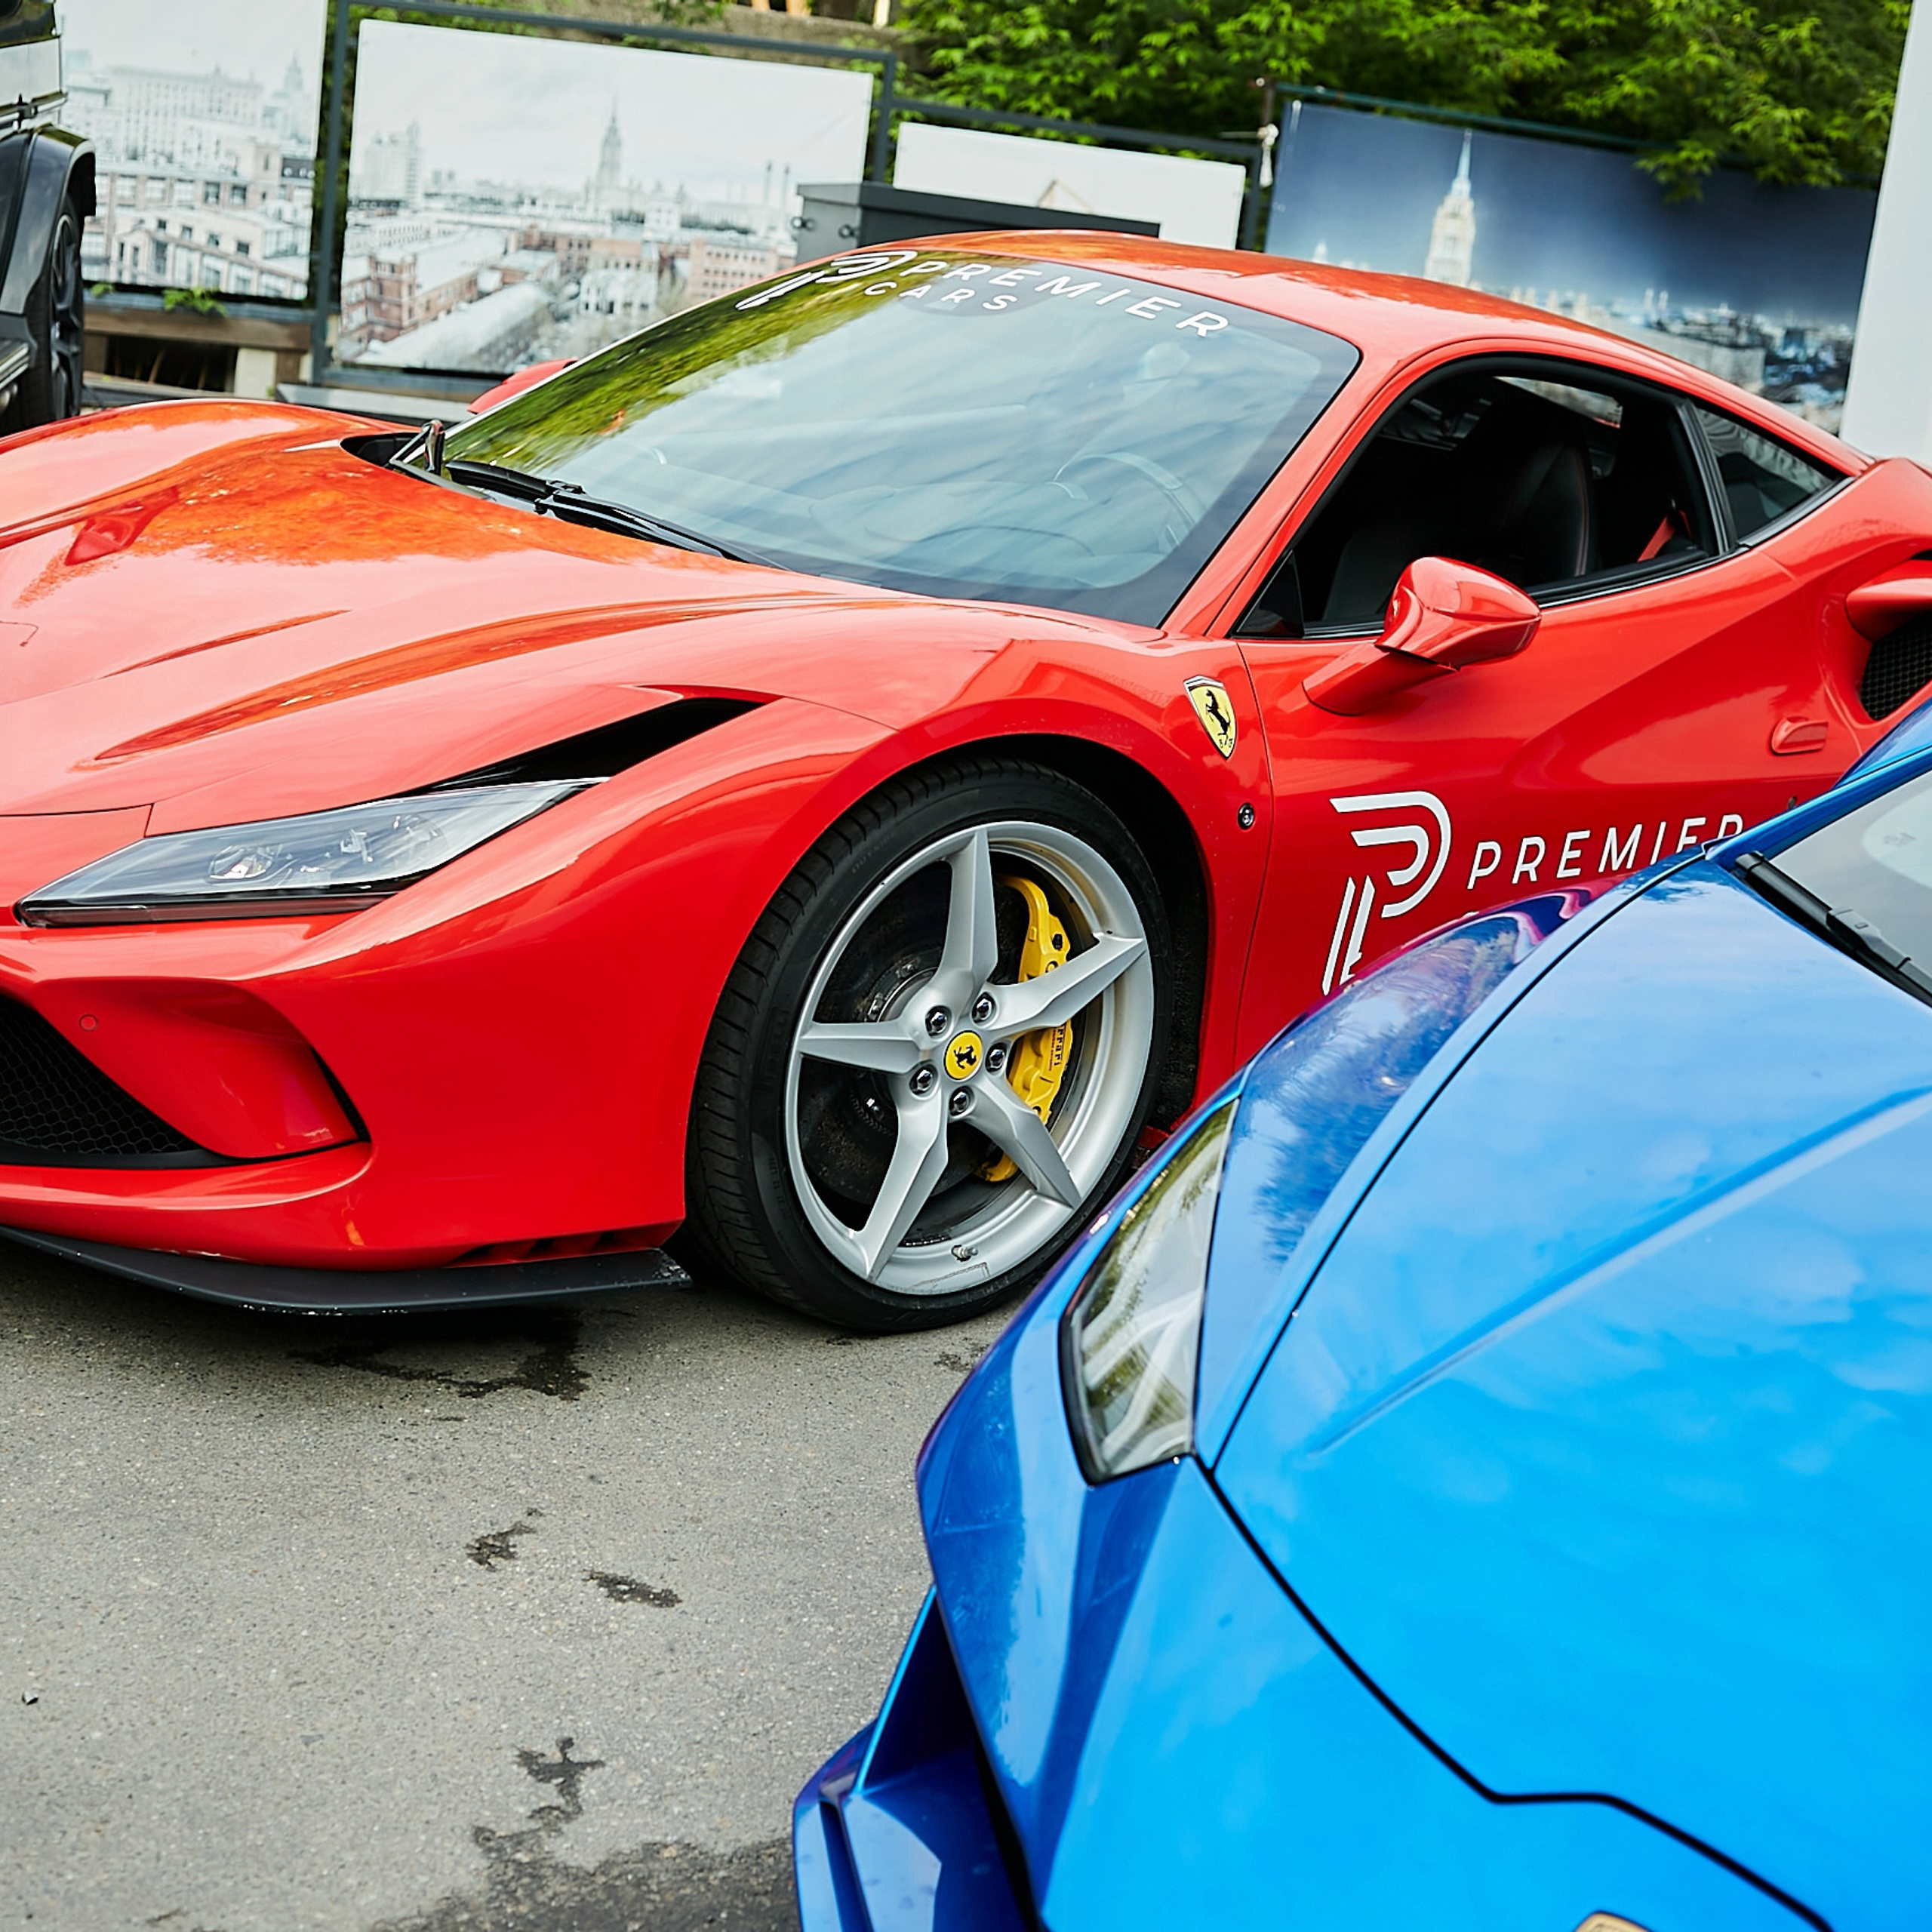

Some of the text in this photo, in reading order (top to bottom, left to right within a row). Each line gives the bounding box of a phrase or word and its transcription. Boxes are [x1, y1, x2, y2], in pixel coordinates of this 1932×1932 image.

[864, 281, 1018, 311] CARS
[899, 261, 1229, 337] PREMIER
[1054, 1026, 1066, 1066] rrari
